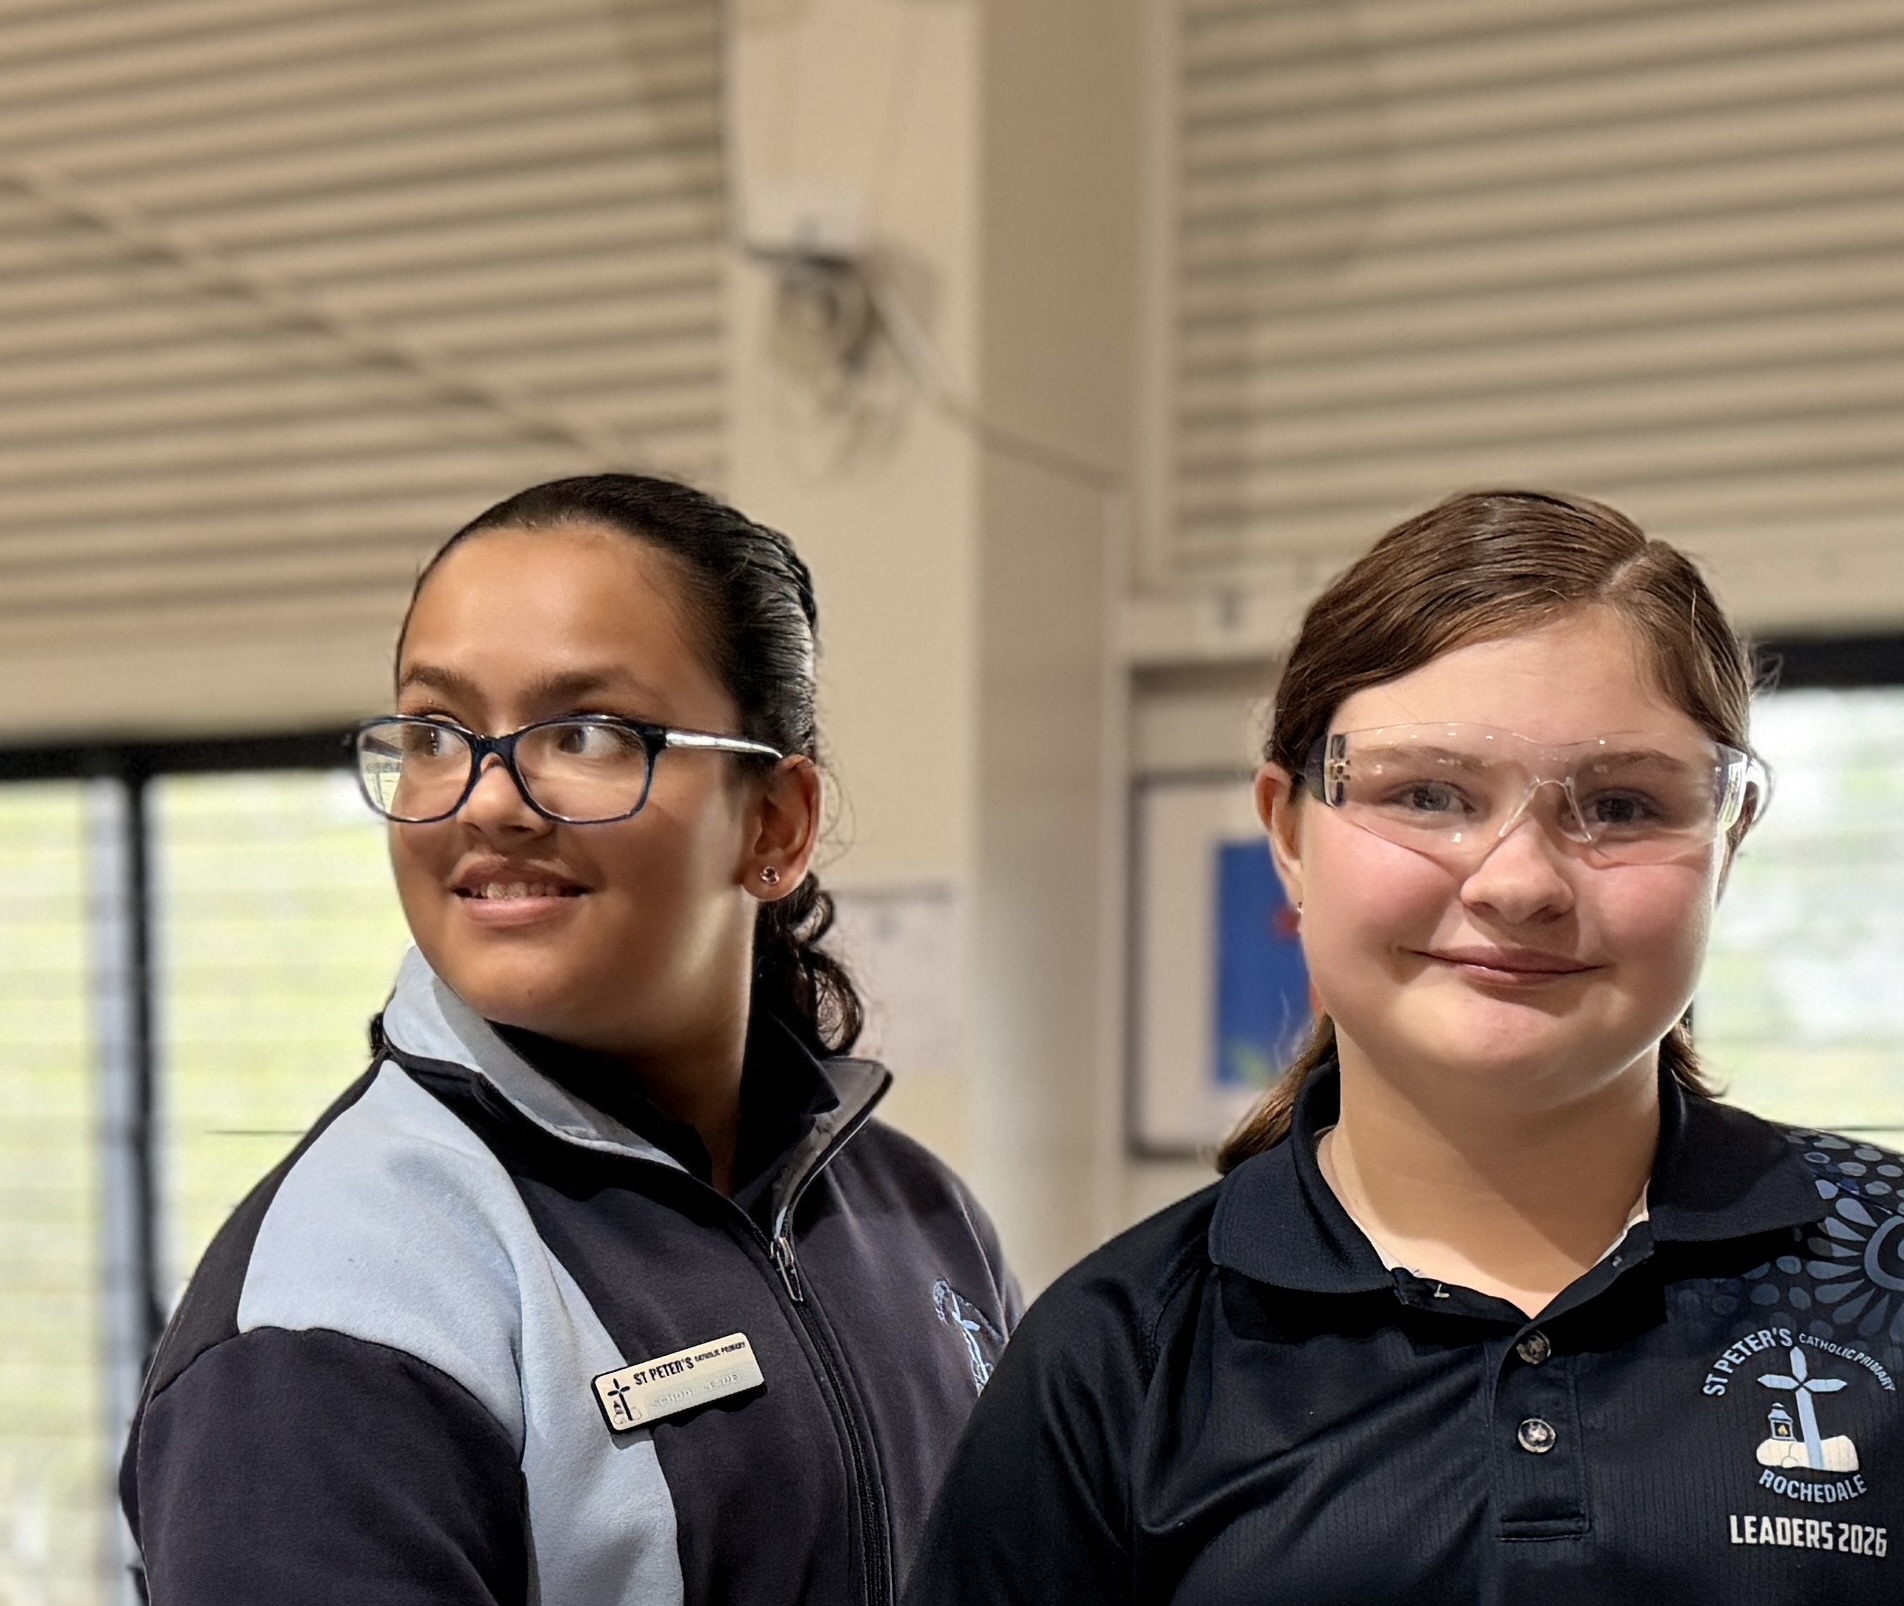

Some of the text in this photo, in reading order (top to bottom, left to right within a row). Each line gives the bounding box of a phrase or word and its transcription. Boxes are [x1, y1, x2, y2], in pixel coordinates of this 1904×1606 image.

[633, 1372, 649, 1386] ST
[650, 1357, 694, 1382] PETER'S
[1702, 1327, 1896, 1396] ST PETER'S CATHOLIC PRIMARY
[1758, 1468, 1868, 1504] ROCHEDALE
[1729, 1514, 1888, 1558] LEADERS 2026
